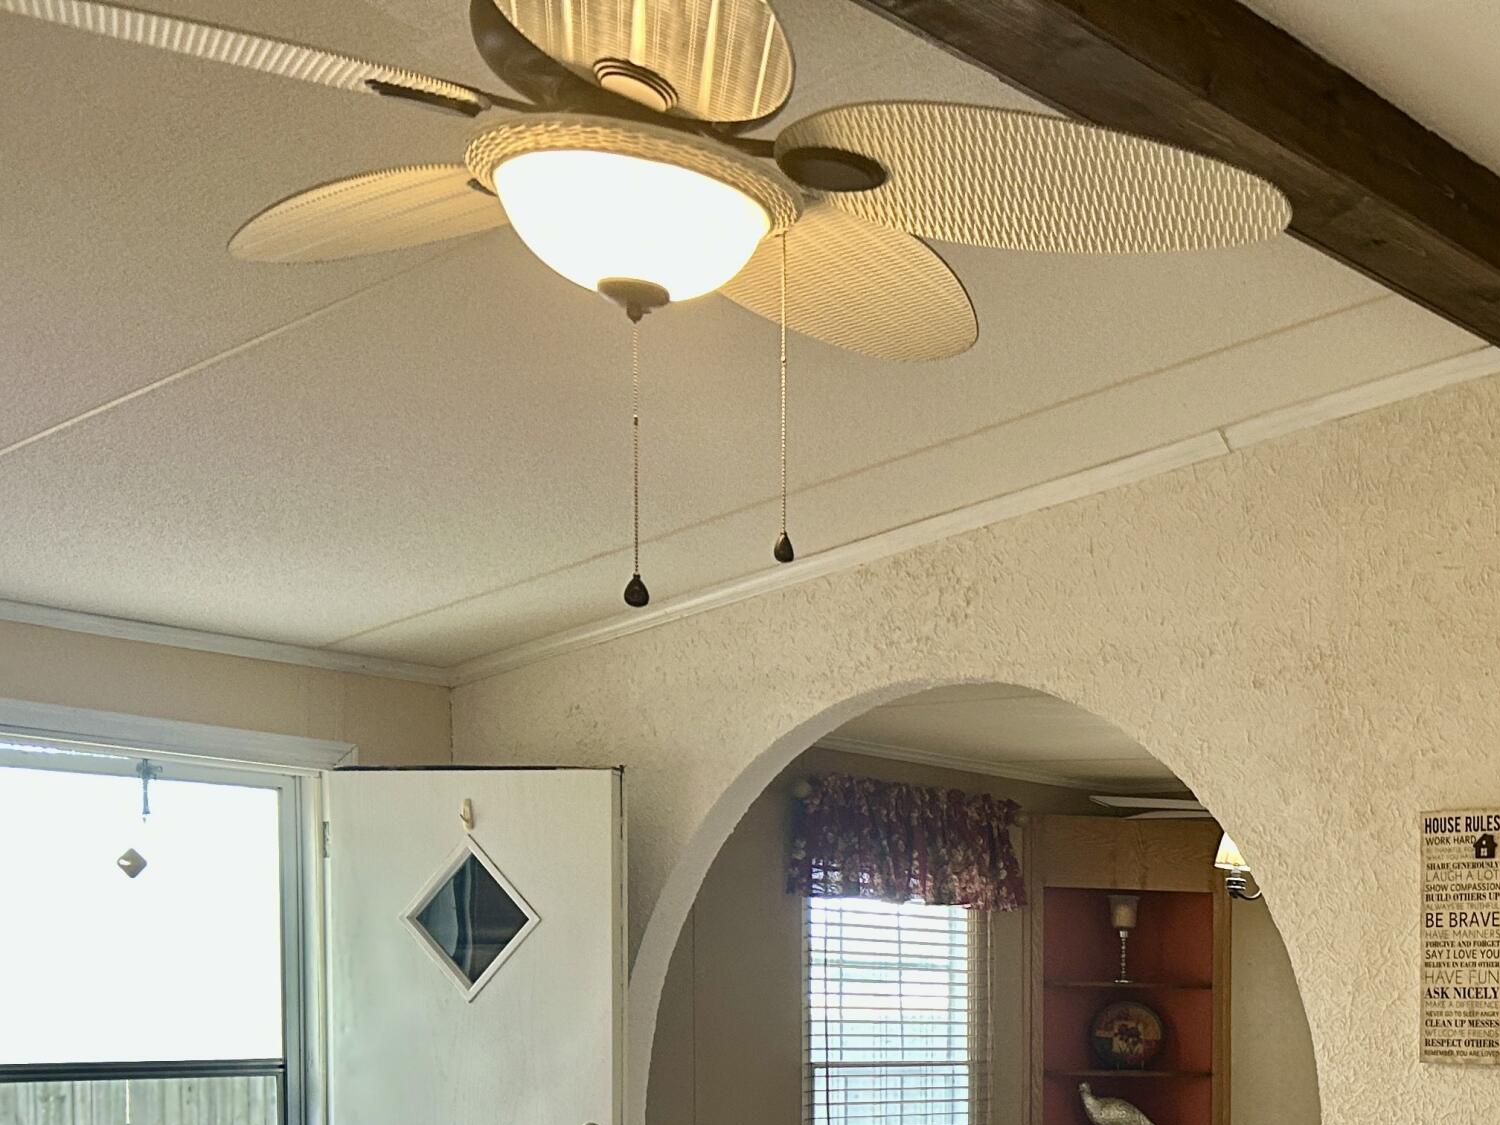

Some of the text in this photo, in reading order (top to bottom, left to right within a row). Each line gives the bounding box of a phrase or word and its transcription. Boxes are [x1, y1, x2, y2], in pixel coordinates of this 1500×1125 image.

[1425, 815, 1500, 834] HOUSE RULES
[1426, 835, 1476, 845] WORK HARD
[1452, 861, 1499, 869] GENEROUSLY
[1426, 870, 1498, 882] LAUGH A LOT
[1425, 883, 1500, 892] SHOW COMPASSION
[1425, 892, 1500, 902] BUILD OTHERS UP
[1425, 911, 1500, 928] BE BRAVE
[1425, 929, 1500, 939] HAVE MANNERS
[1425, 949, 1499, 959] SAY I LOVE YOU
[1425, 970, 1499, 984] HAVE FUN
[1424, 987, 1499, 999] ASK NICELY
[1425, 1019, 1452, 1027] CLEAN
[1468, 1030, 1499, 1038] FRIENDS
[1424, 1039, 1499, 1048] RESPECT OTHERS
